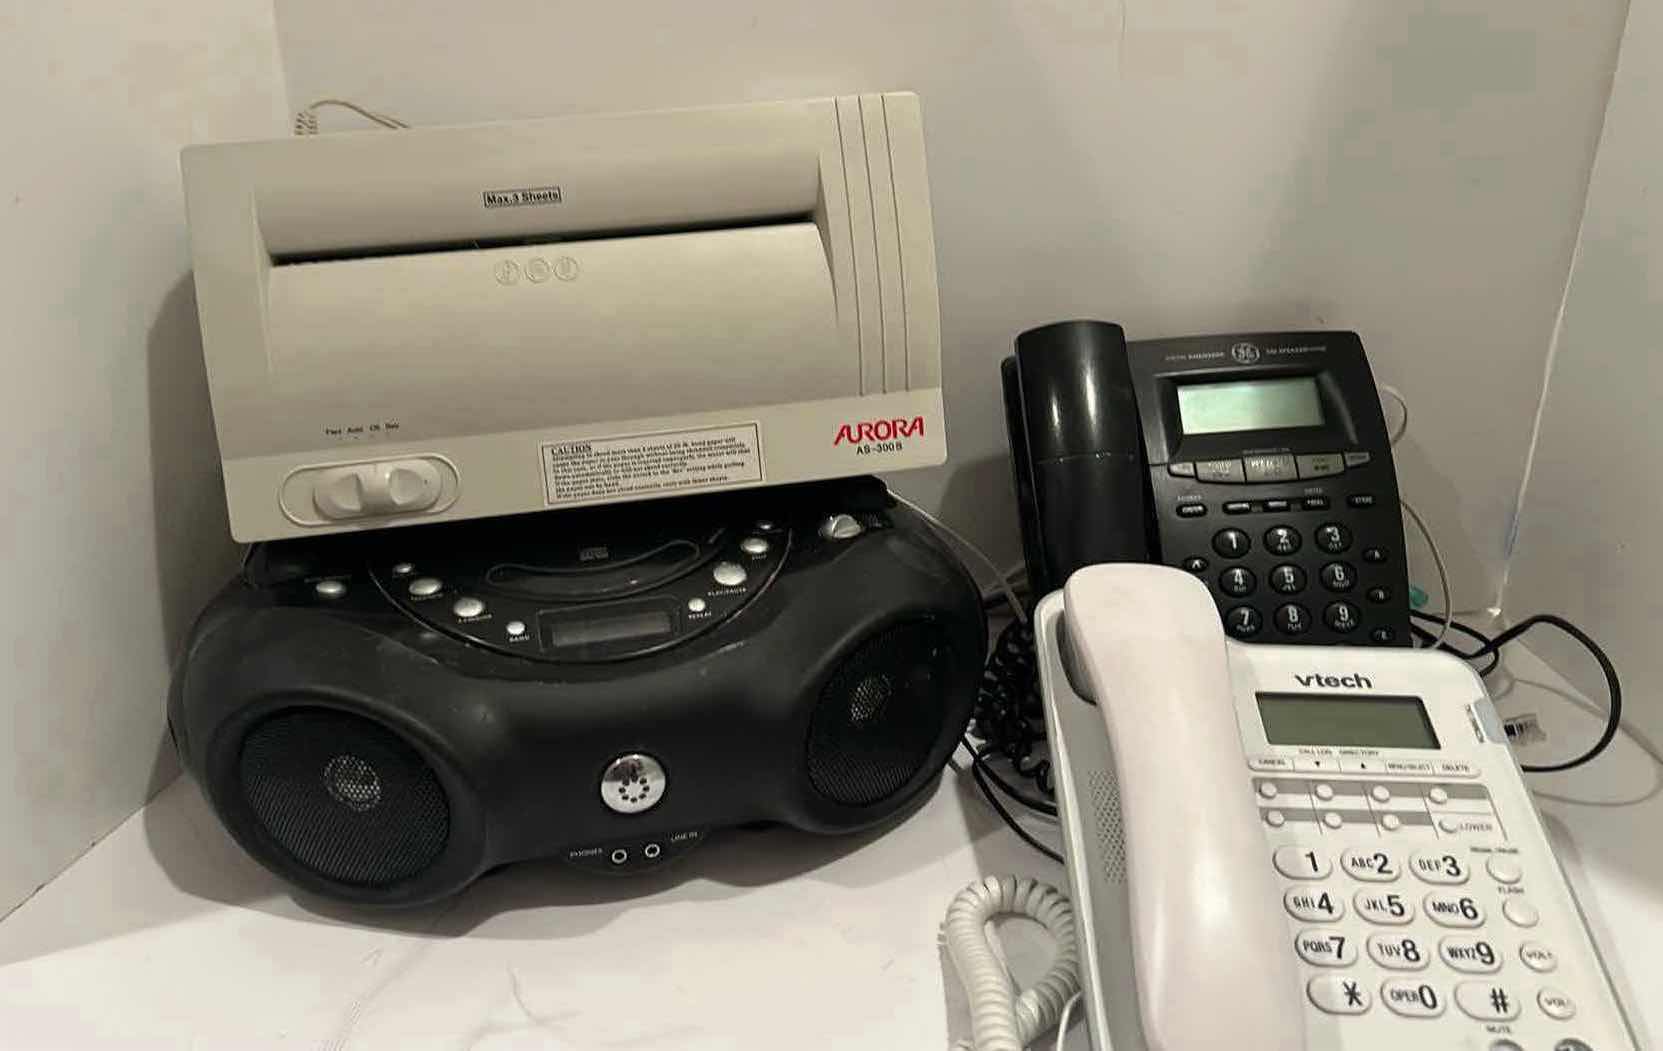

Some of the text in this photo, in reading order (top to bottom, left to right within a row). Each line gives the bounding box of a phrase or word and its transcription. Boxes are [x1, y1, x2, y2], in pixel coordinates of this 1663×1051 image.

[834, 416, 925, 446] AURORA
[1227, 526, 1340, 549] 1 2 3
[1234, 565, 1345, 585] 4 5 6
[1240, 605, 1349, 625] 7 8 9
[1294, 673, 1373, 688] vtech
[1304, 851, 1319, 872] 1
[1489, 987, 1508, 1013] #
